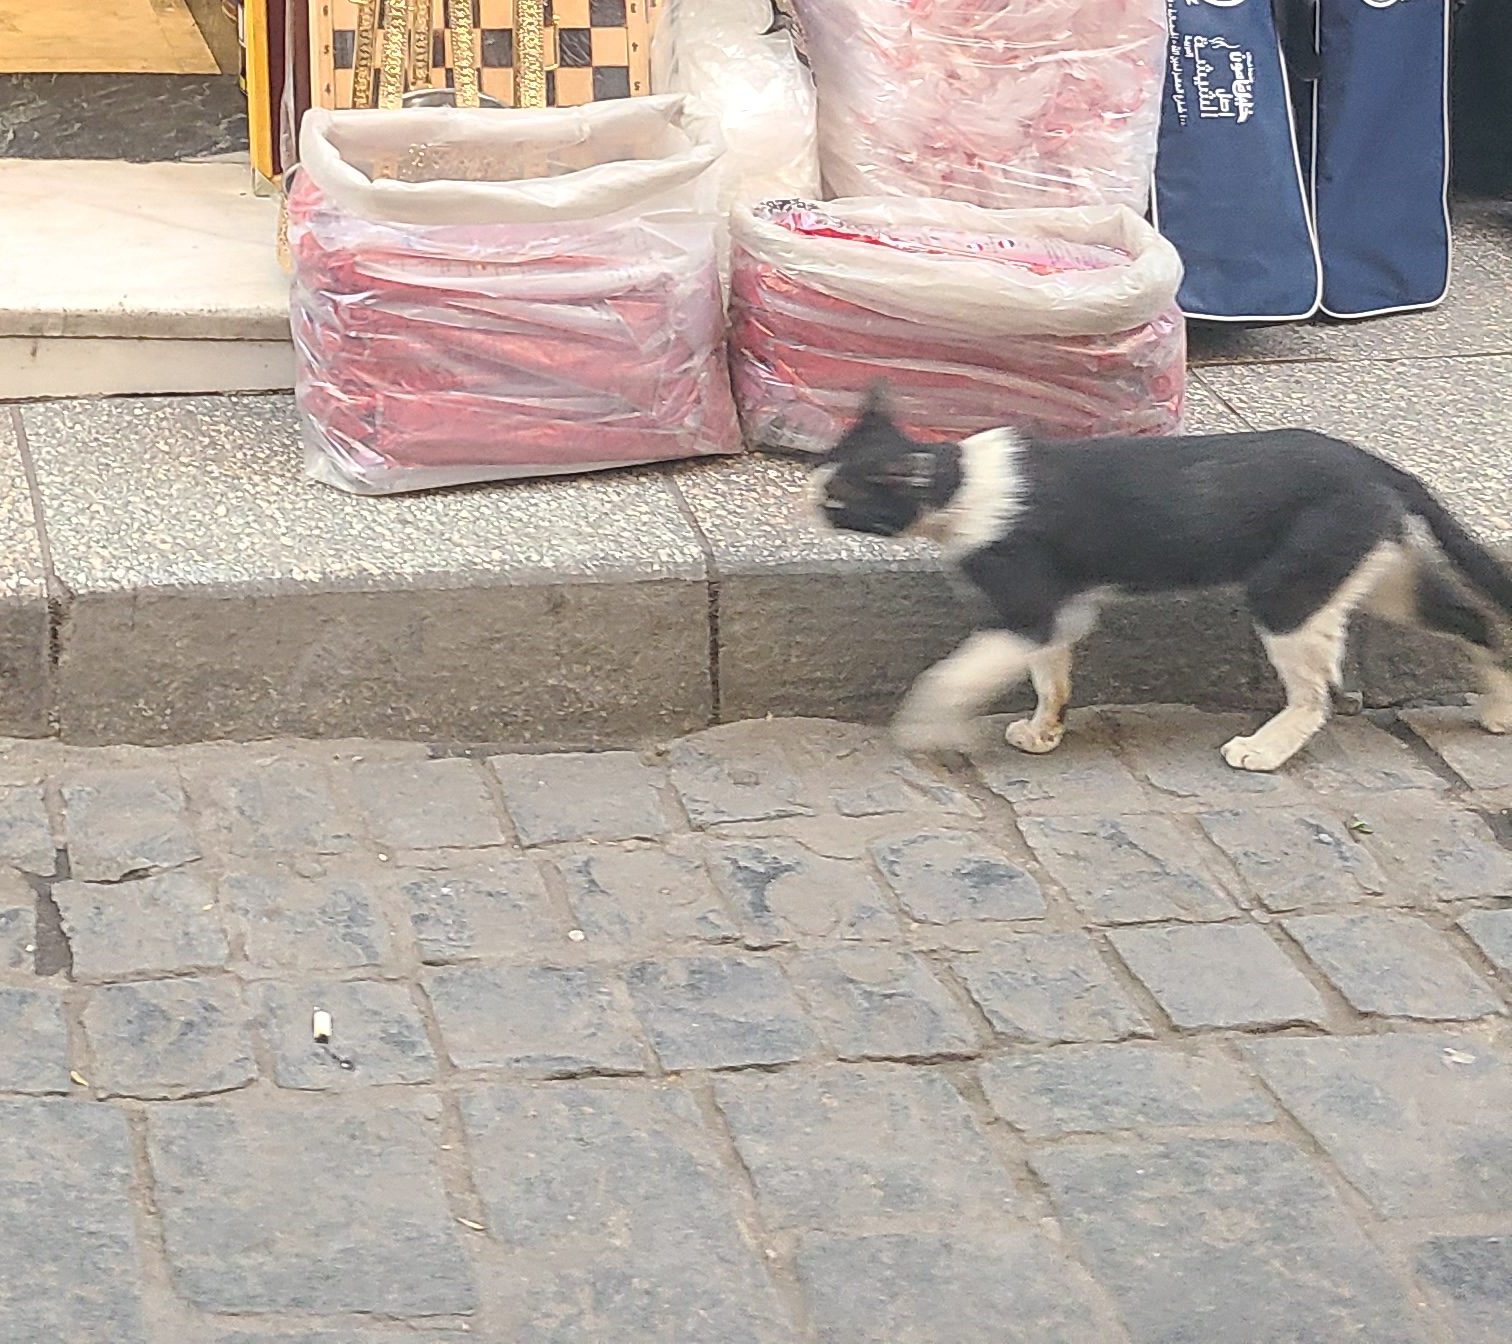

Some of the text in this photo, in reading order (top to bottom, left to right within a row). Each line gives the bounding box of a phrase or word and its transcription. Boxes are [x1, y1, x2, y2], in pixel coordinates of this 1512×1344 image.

[1193, 35, 1219, 118] الشيشة
[1229, 51, 1251, 92] مأمون
[1232, 80, 1254, 123] خليل
